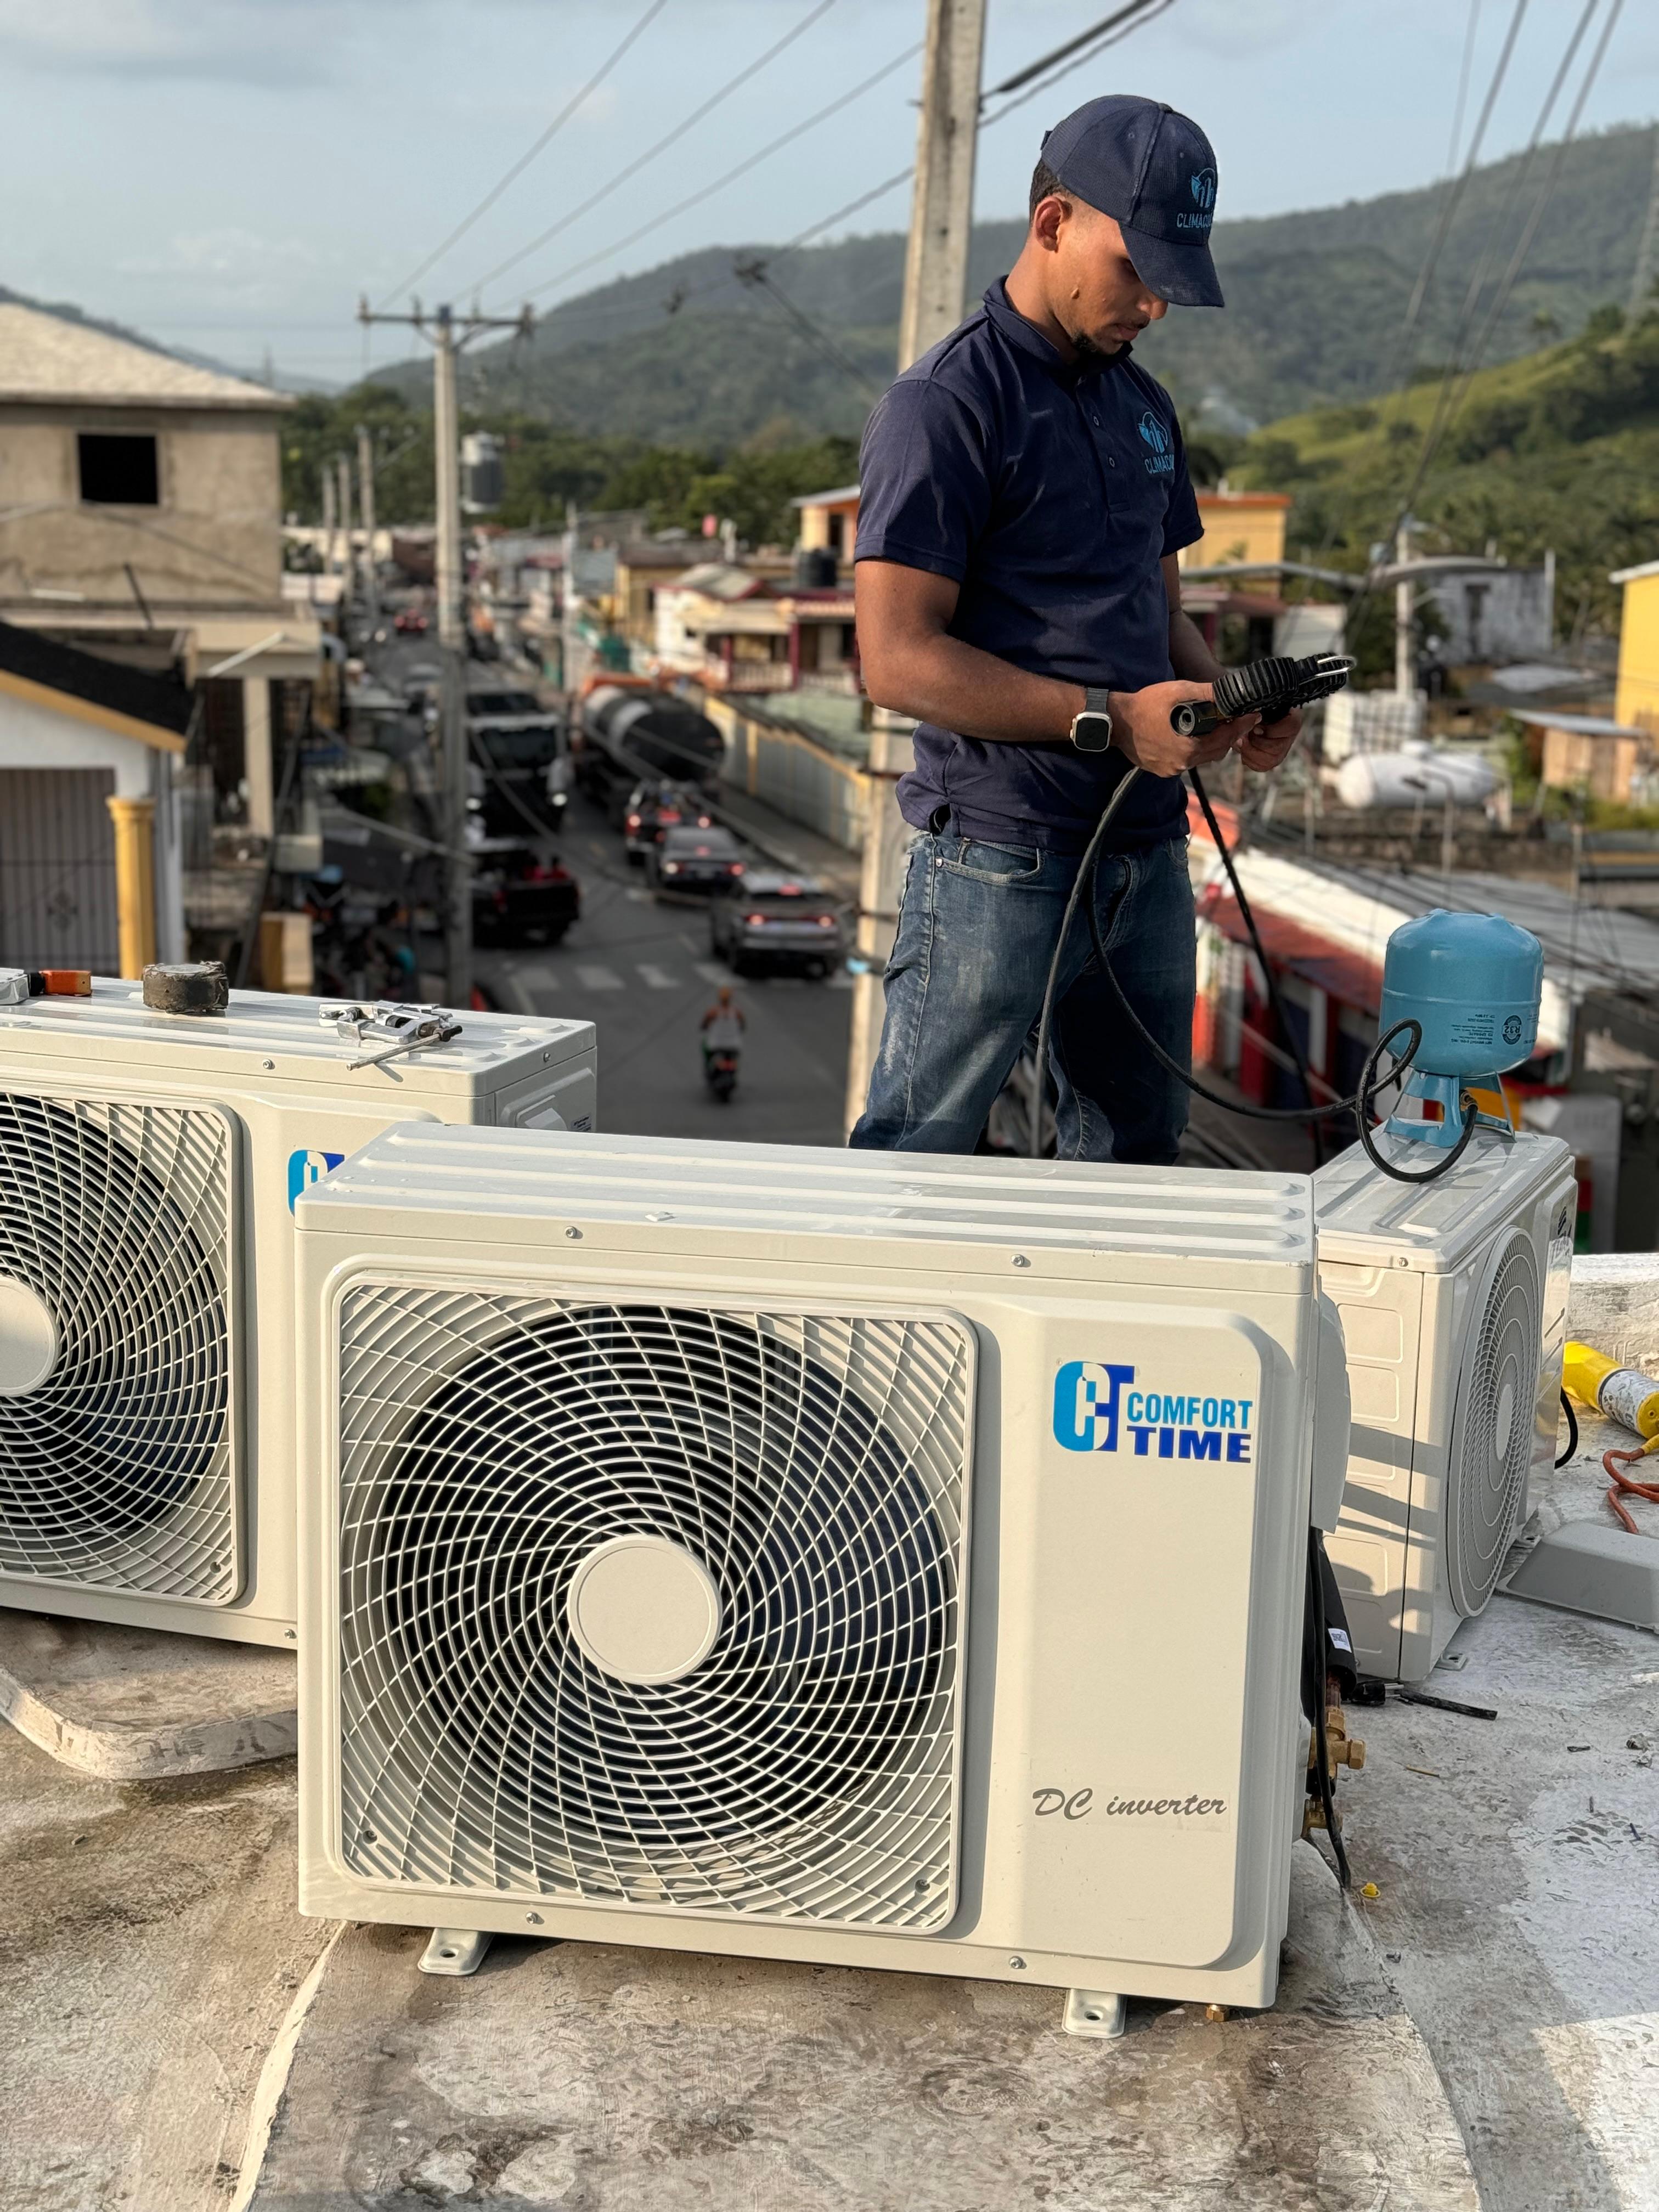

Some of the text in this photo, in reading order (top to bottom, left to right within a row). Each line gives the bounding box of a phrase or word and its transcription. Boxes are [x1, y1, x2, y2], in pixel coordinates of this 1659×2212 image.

[1504, 1025, 1520, 1034] R32
[1127, 1392, 1253, 1430] COMFORT
[1126, 1425, 1252, 1464] TIME
[1032, 1788, 1227, 1820] DC inverter
